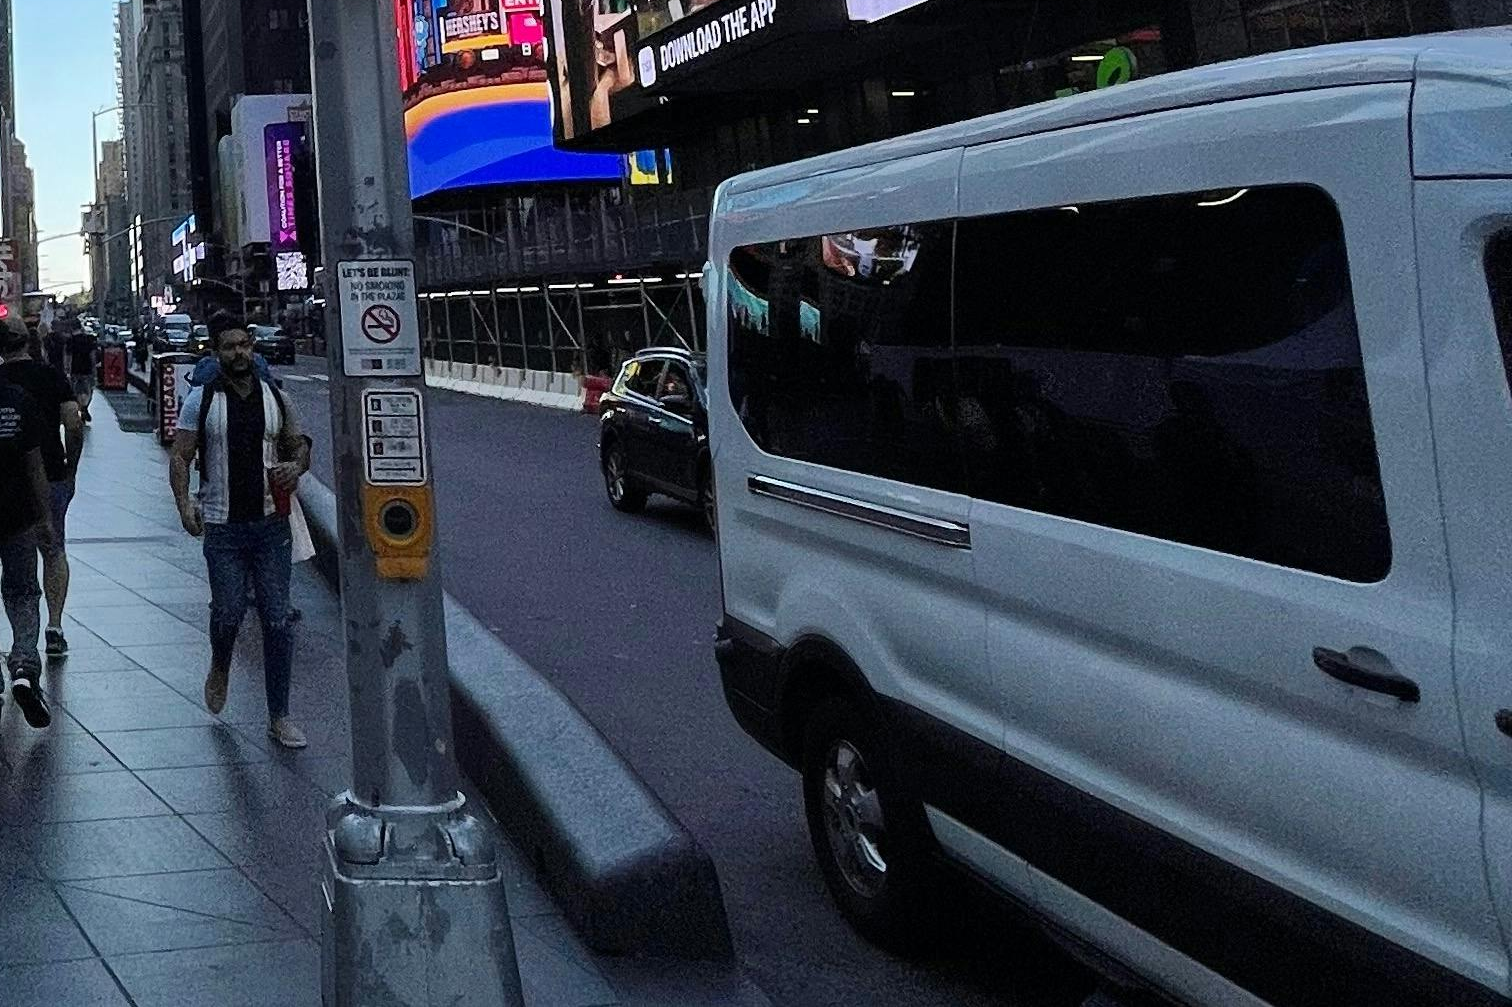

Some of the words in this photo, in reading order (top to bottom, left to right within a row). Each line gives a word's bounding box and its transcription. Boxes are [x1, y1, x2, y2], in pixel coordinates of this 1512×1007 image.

[445, 11, 499, 37] HERSHEY'S
[660, 20, 721, 71] DOWNLOAD
[721, 6, 749, 43] THE
